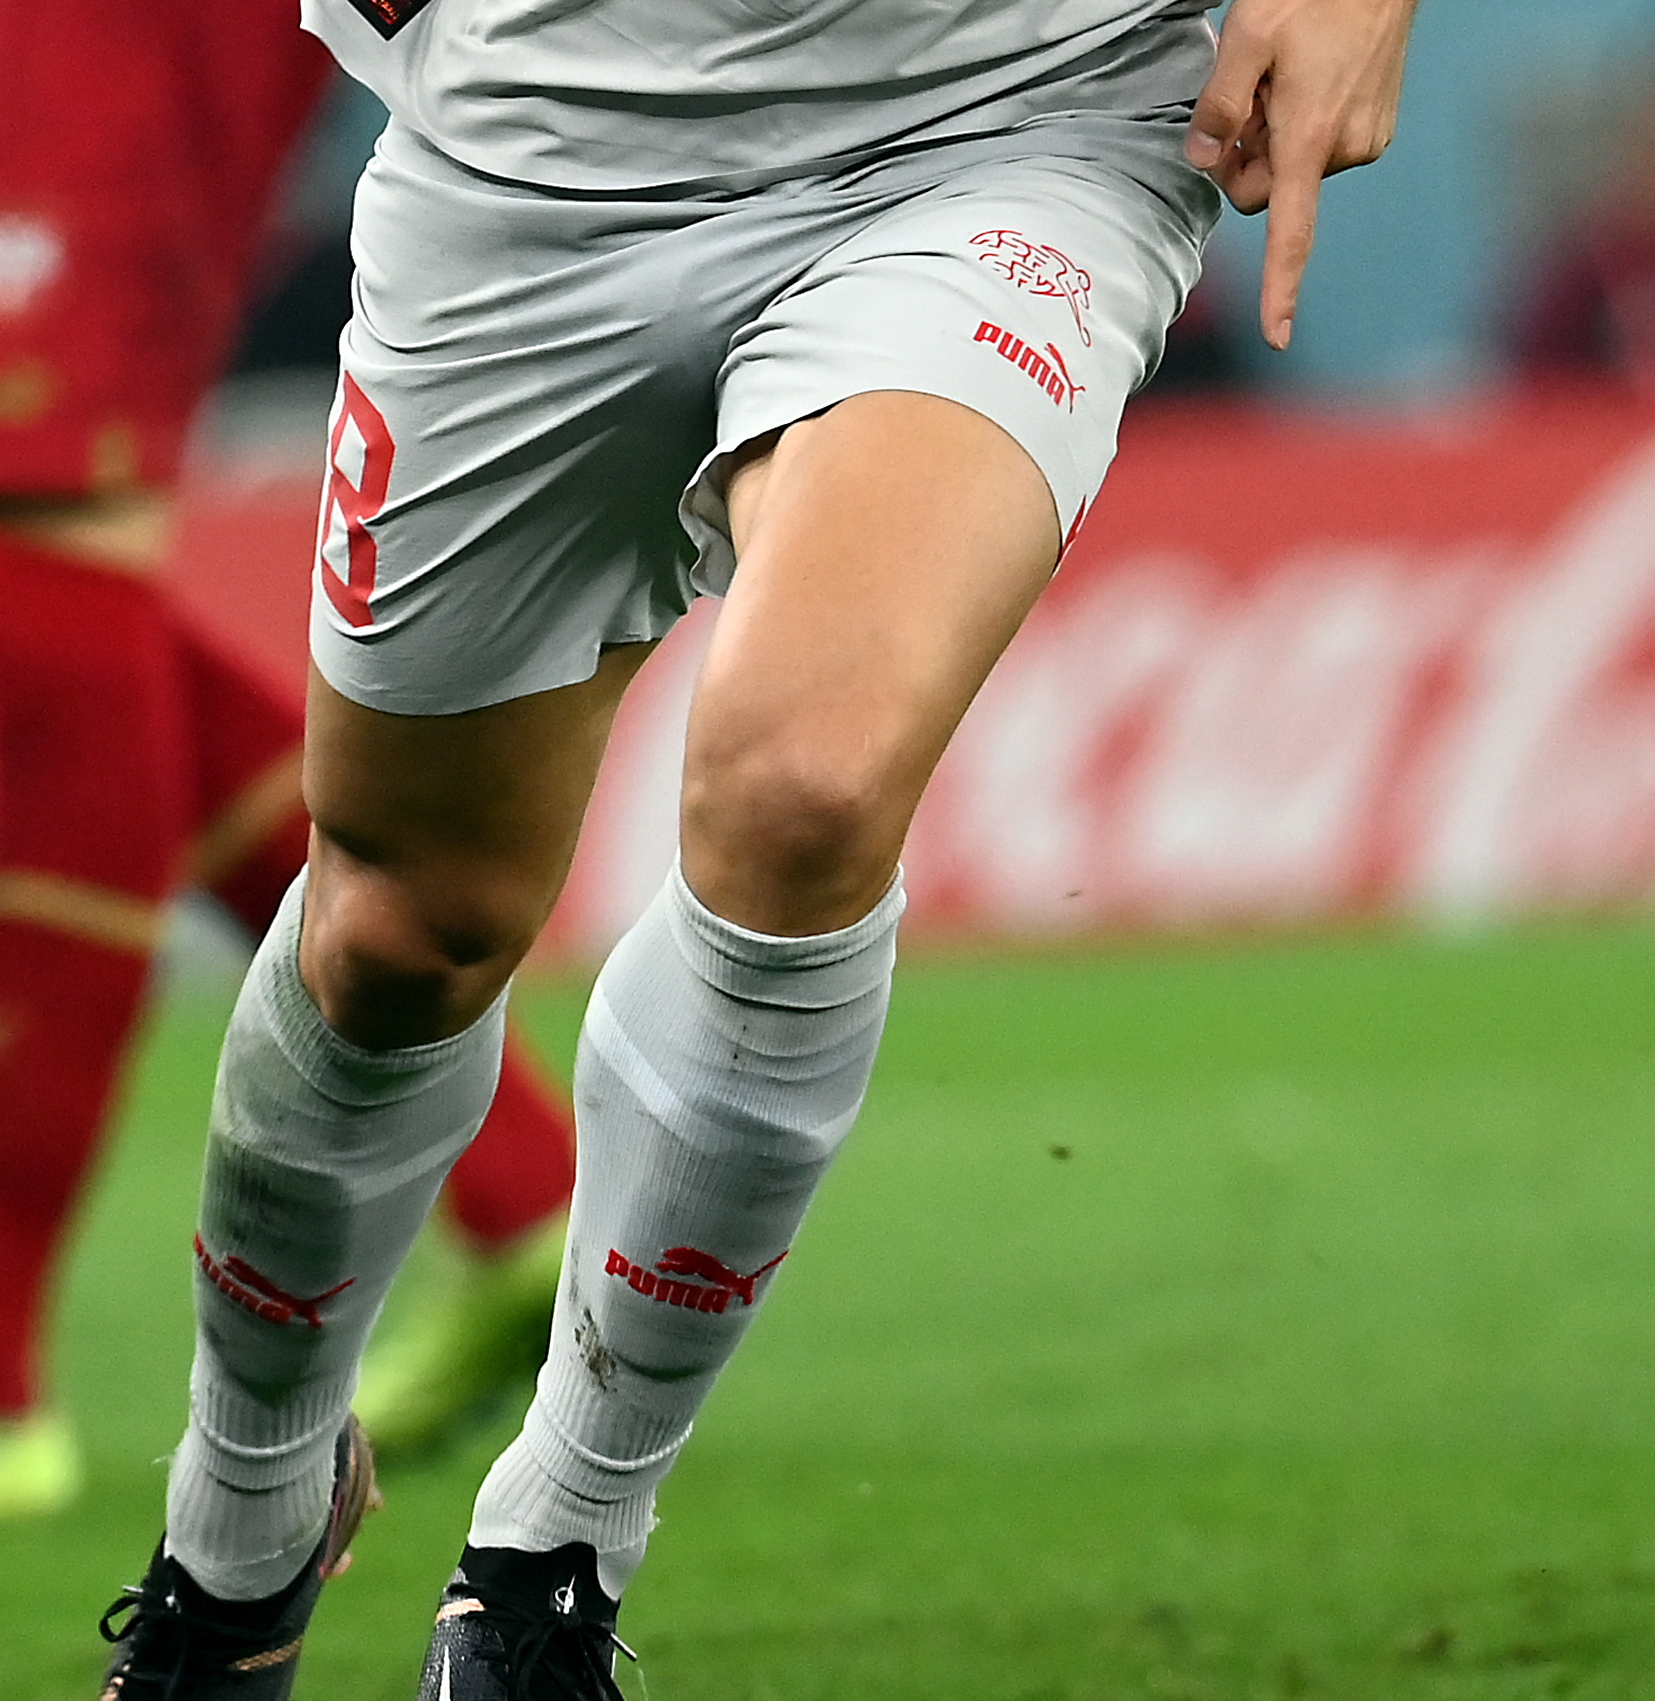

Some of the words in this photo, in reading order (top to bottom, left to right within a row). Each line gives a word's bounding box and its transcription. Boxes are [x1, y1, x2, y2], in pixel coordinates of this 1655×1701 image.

[972, 320, 1066, 407] PUMA
[321, 369, 396, 629] 8
[604, 1248, 734, 1314] PUMA
